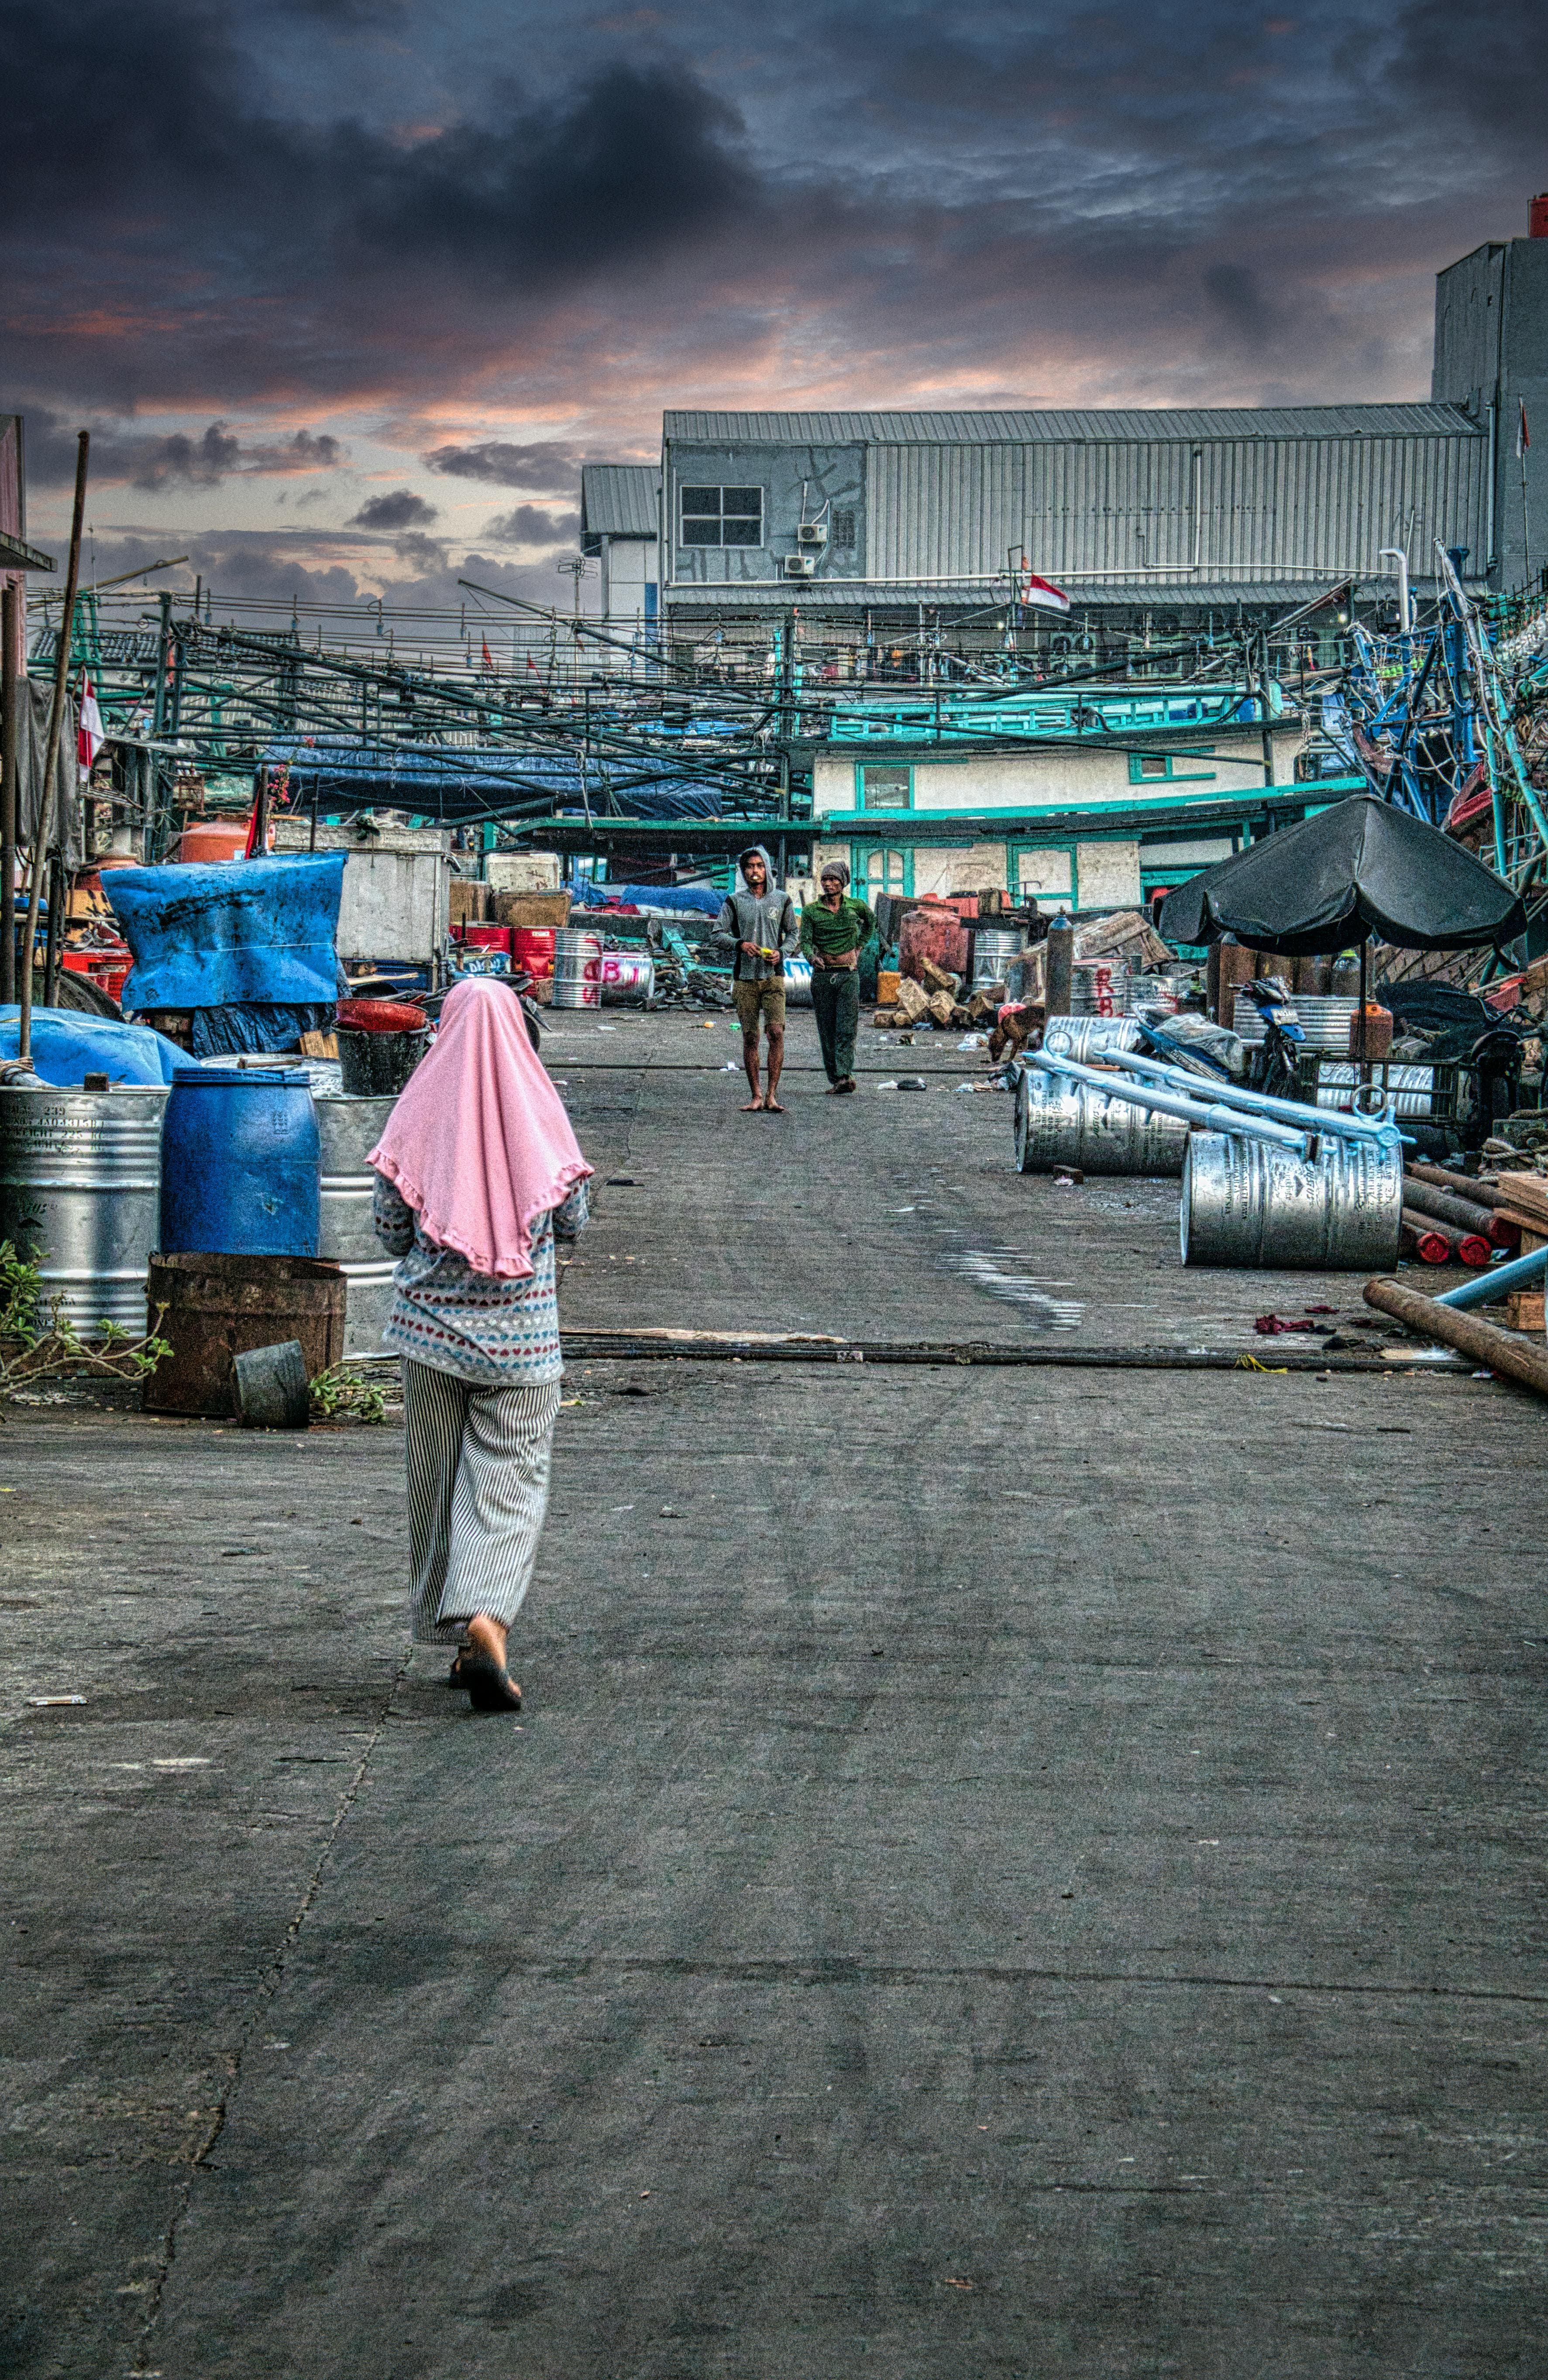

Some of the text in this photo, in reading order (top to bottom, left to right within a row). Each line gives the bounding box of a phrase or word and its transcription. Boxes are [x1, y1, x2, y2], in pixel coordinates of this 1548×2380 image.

[44, 1106, 66, 1116] 239
[61, 1130, 83, 1139] 225
[1305, 1165, 1314, 1200] JUSTUS
